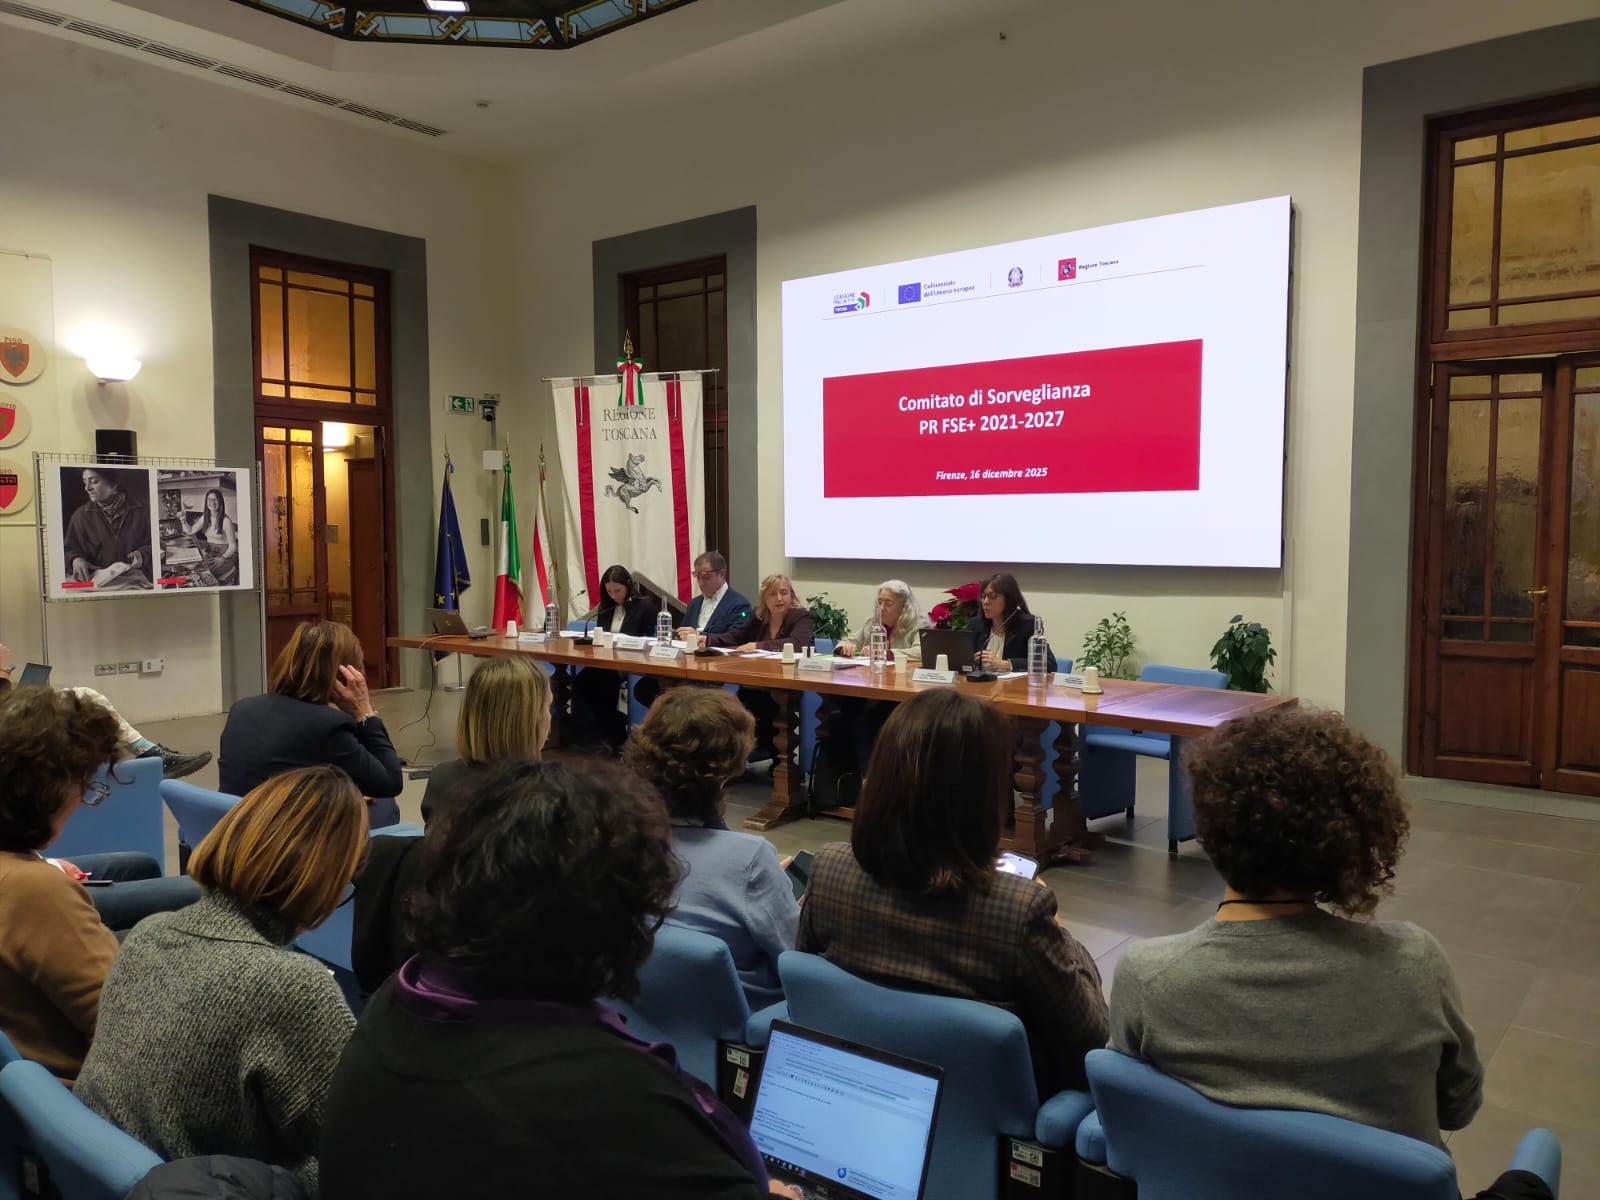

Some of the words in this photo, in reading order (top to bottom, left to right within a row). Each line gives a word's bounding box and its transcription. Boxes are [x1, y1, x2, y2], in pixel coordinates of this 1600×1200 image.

[898, 393, 965, 412] Comitato
[968, 388, 983, 406] di
[987, 383, 1091, 405] Sorveglianza
[919, 419, 938, 435] PR
[941, 417, 976, 433] FSE+
[980, 410, 1065, 431] 2021-2027
[601, 427, 657, 441] TOSCANA
[936, 471, 968, 480] Firenze,
[970, 470, 981, 479] 16
[982, 469, 1023, 479] dicembre
[1025, 467, 1048, 477] 2025
